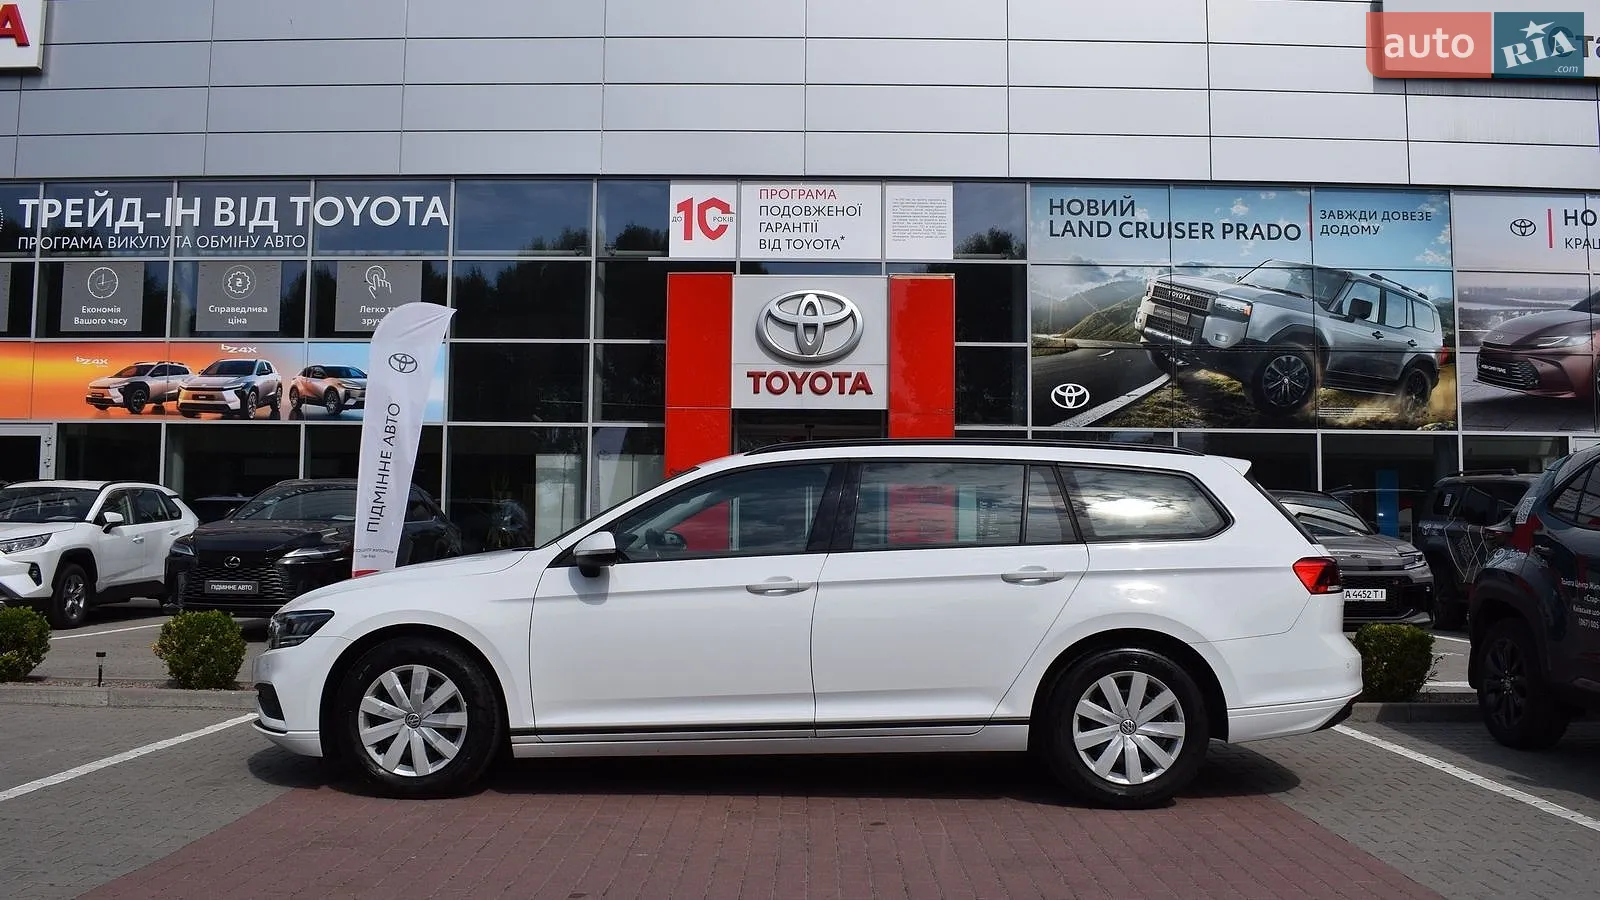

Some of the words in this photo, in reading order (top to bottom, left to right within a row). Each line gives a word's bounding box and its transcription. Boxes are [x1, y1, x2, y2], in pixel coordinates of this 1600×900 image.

[759, 188, 837, 200] ПРОГРАМА
[18, 190, 200, 234] ТРЕЙД-ІН
[214, 196, 279, 233] ВІД
[289, 196, 450, 227] TOYOTA
[759, 203, 863, 219] ПОДОВЖЕНОЇ
[1049, 195, 1136, 217] НОВИЙ
[1319, 209, 1378, 222] ЗАВЖДИ
[1381, 210, 1432, 223] ДОВЕЗЕ
[759, 219, 819, 233] ГАРАНТІЇ
[1049, 219, 1113, 238] LAND
[1118, 220, 1216, 240] CRUISER
[1221, 222, 1302, 242] PRADO
[1319, 224, 1381, 237] ДОДОМУ
[17, 235, 103, 250] ПРОГРАМА
[107, 235, 171, 249] ВИКУПУ
[174, 235, 193, 249] ТА
[196, 234, 260, 249] ОБМІНУ
[263, 234, 306, 248] АВТО
[759, 238, 782, 252] ВІД
[81, 304, 121, 314] Економія
[208, 304, 268, 315] Справедлива
[360, 305, 386, 313] Легко
[74, 317, 107, 326] Вашого
[108, 317, 128, 327] часу
[228, 316, 248, 326] ціна
[746, 371, 874, 396] TOYOTA
[366, 450, 393, 533] ПІДМІННЕ
[383, 402, 401, 447] АВТО
[1352, 590, 1372, 599] 4452
